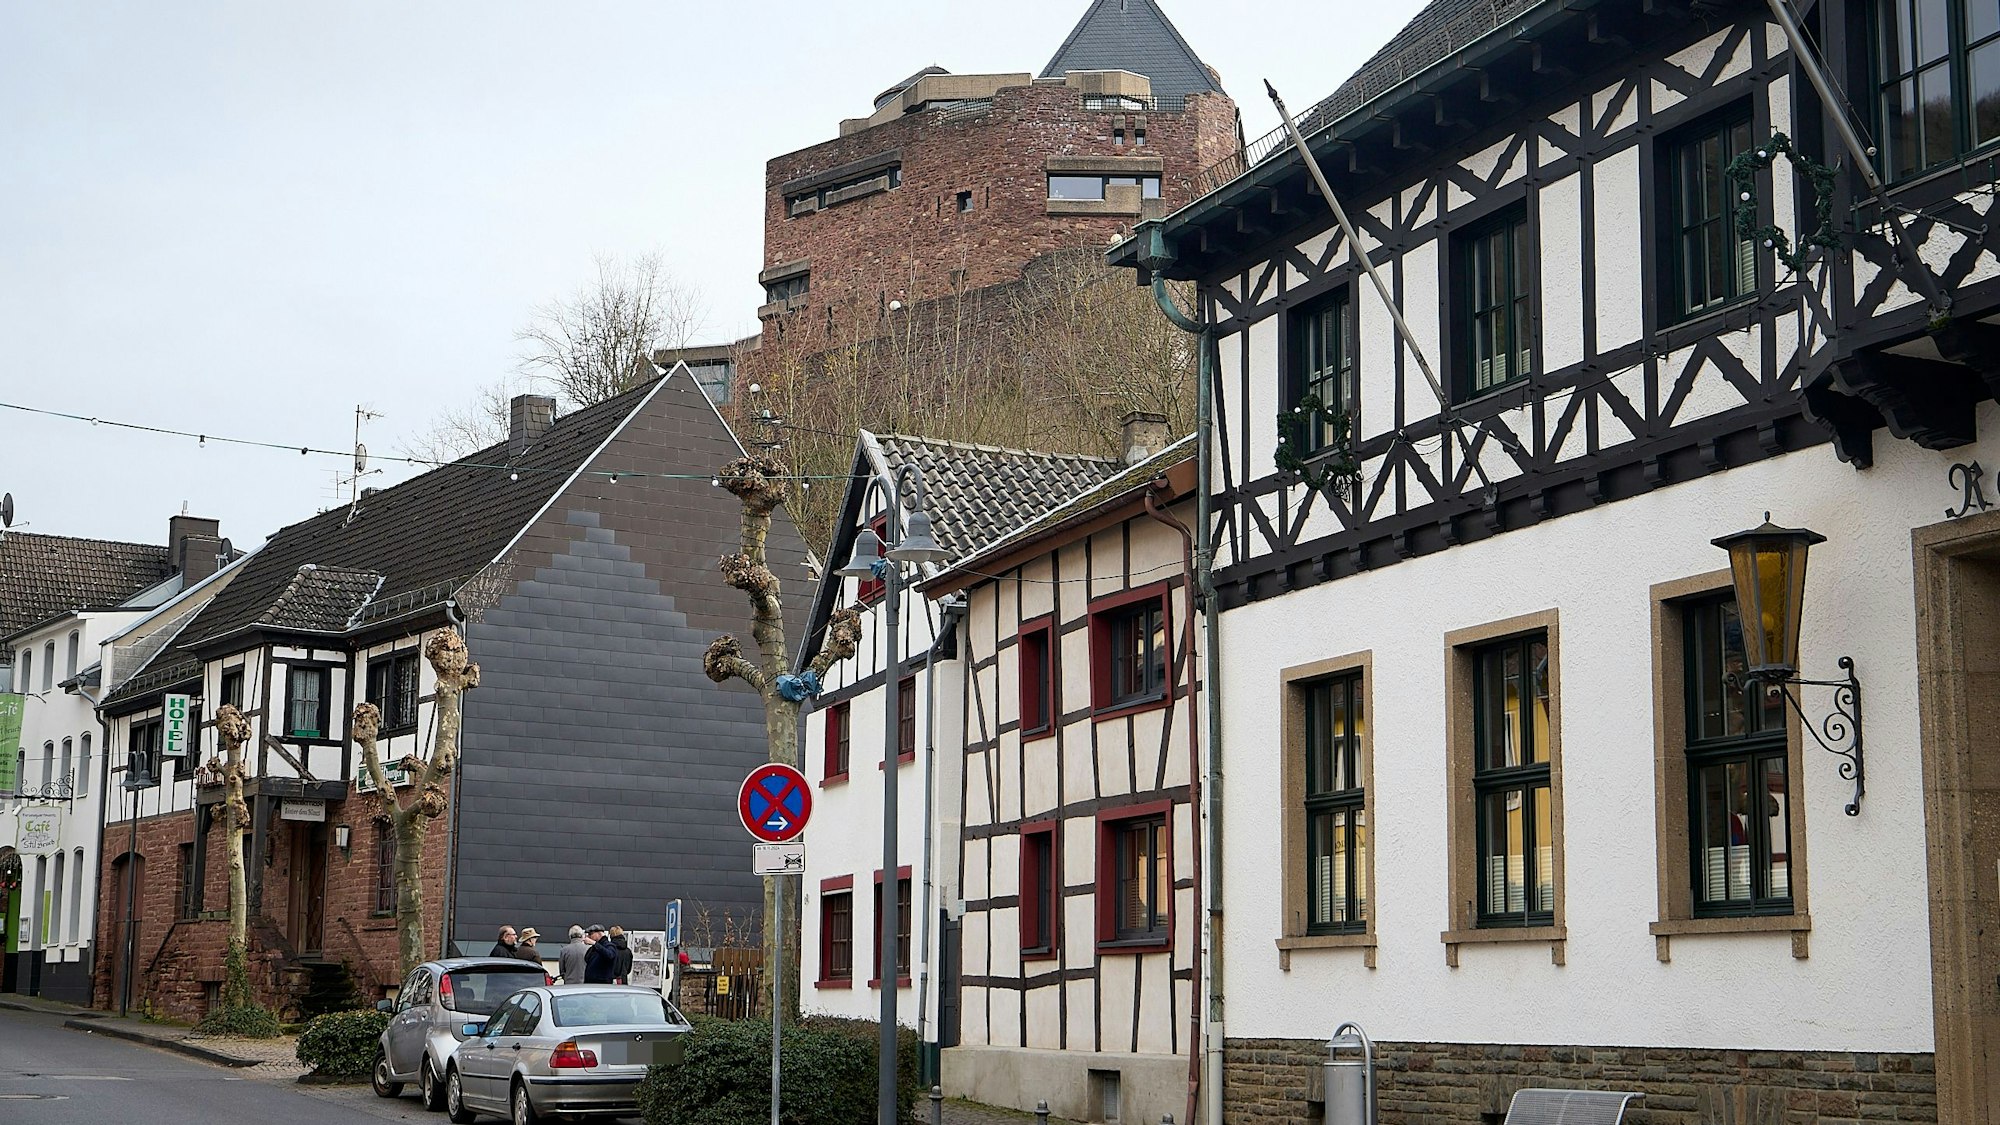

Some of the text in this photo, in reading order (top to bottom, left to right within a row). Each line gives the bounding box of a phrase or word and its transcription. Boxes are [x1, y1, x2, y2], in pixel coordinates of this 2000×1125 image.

[168, 697, 185, 752] HOTEL
[25, 820, 51, 833] Café
[669, 908, 676, 941] P
